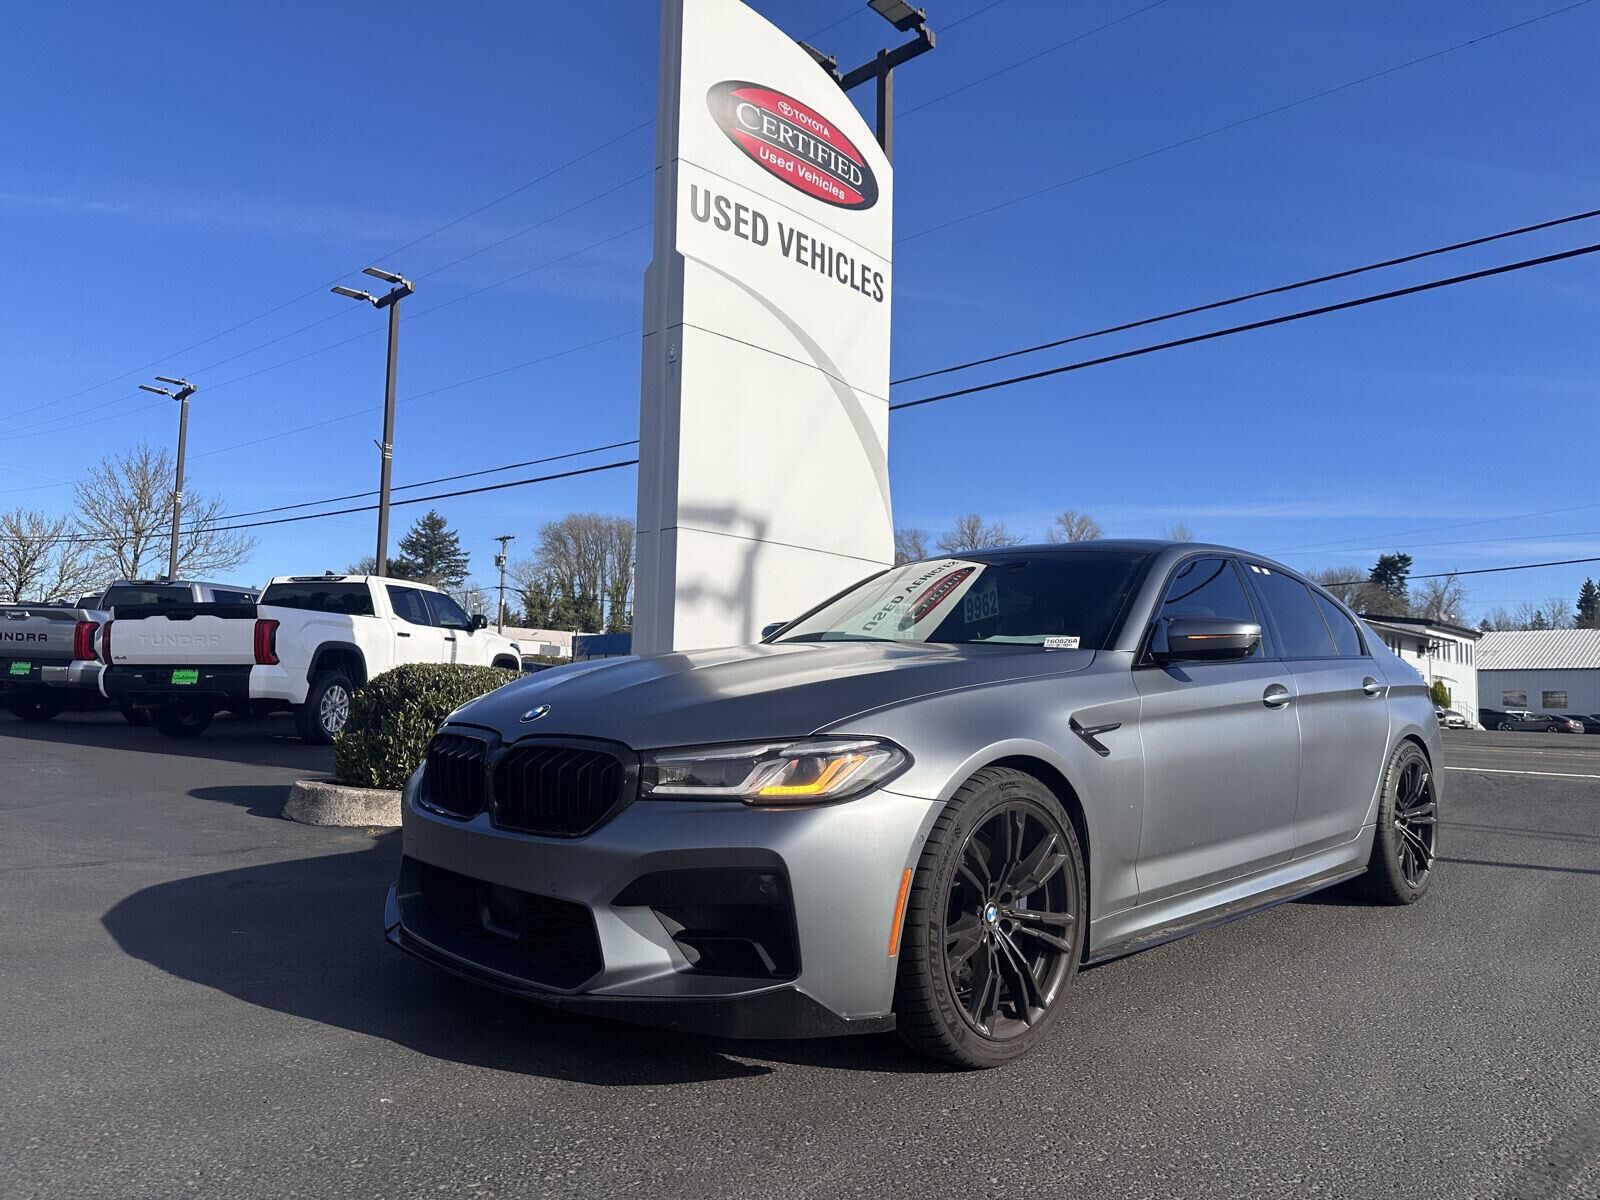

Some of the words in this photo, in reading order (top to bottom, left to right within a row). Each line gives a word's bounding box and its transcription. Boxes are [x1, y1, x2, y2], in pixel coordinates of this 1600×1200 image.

[736, 102, 863, 186] CERTIFIED
[793, 109, 831, 138] TOYOTA
[759, 147, 794, 173] Used
[797, 165, 846, 200] Vehicles
[690, 184, 769, 247] USED
[777, 221, 884, 303] VEHICLES
[0, 632, 47, 642] NDRA
[138, 634, 222, 647] TUNDRA
